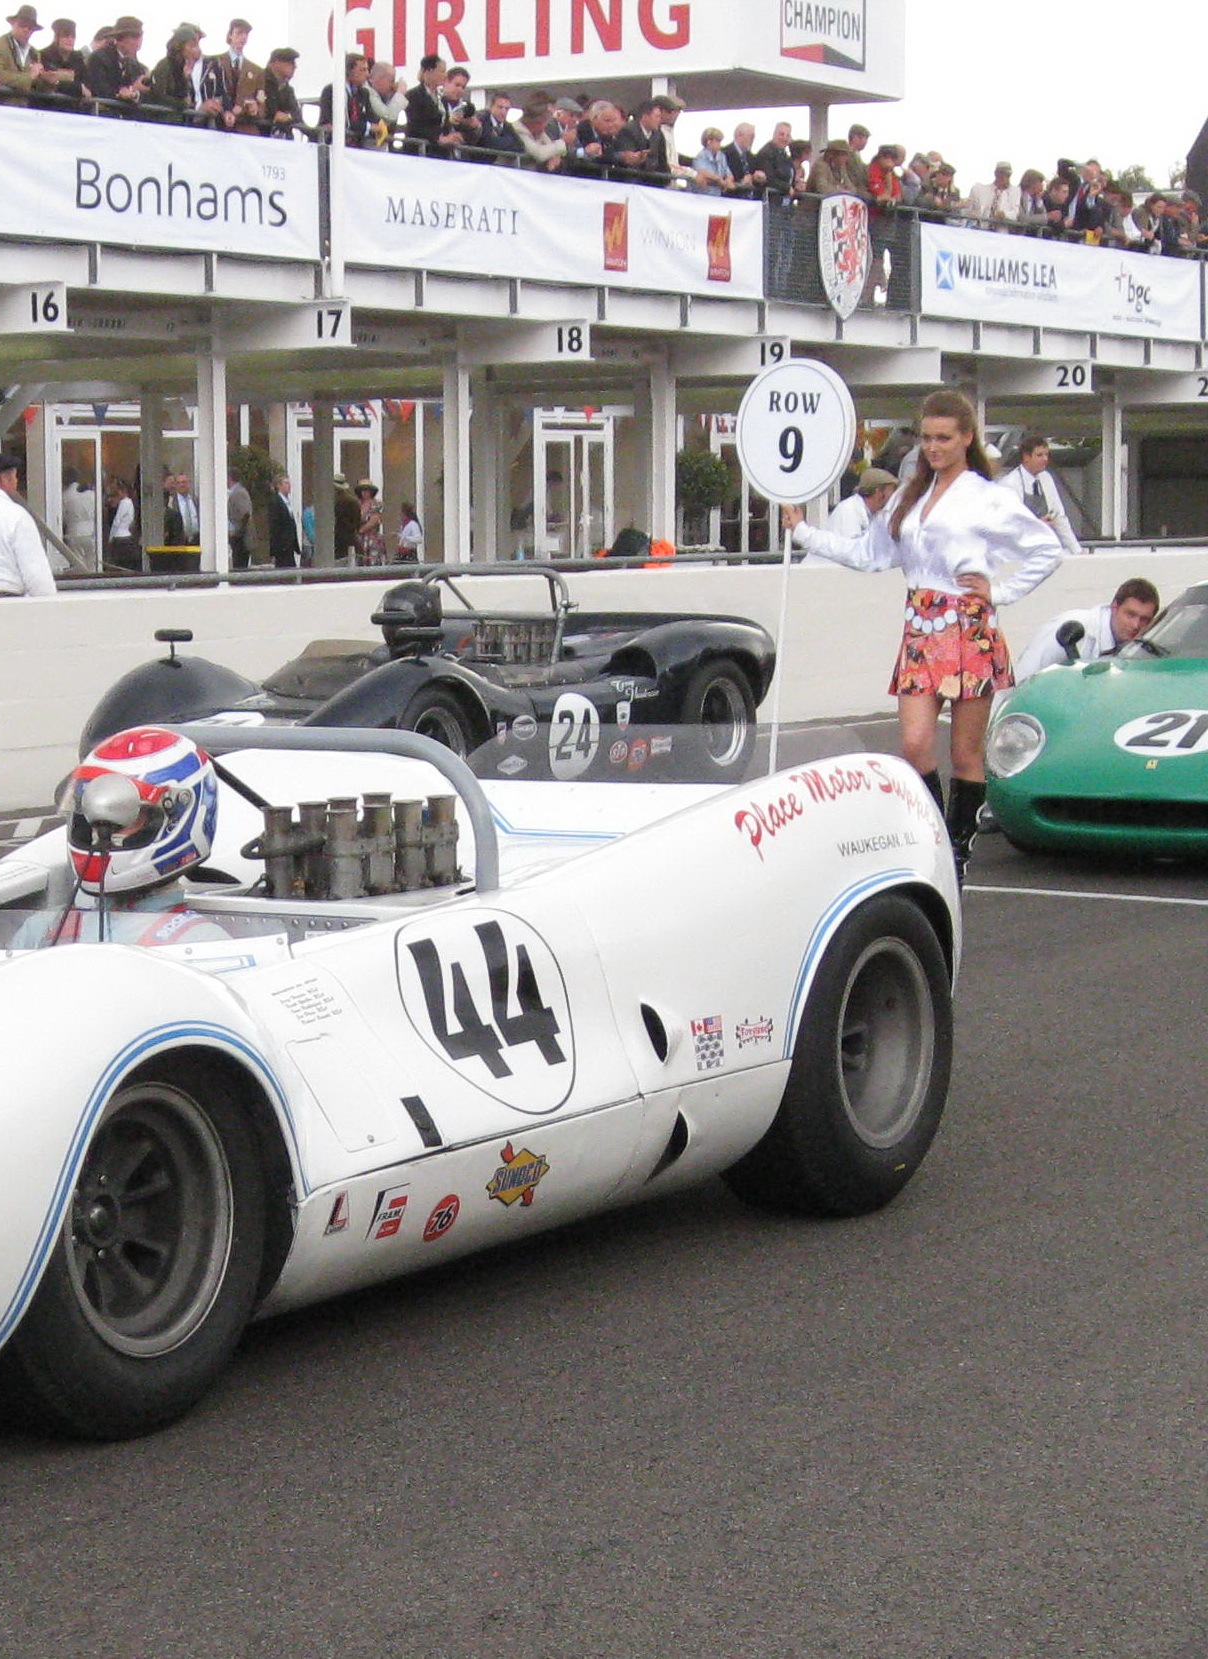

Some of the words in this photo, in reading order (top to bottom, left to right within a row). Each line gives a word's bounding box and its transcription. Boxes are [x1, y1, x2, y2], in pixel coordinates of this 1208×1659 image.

[784, 0, 860, 41] CHAMPION
[262, 164, 286, 181] 1793
[76, 157, 287, 227] Bonhams
[385, 196, 519, 235] MASERATI
[957, 252, 1029, 286] WILLIAMS
[1033, 263, 1057, 290] LEA
[31, 291, 60, 323] 16
[1127, 275, 1151, 313] bgc
[317, 309, 342, 338] 17
[557, 326, 583, 353] 18
[760, 342, 784, 366] 19
[1056, 364, 1086, 388] 20
[769, 390, 821, 413] ROW
[778, 425, 804, 473] 9
[555, 707, 593, 761] 24
[1125, 712, 1208, 748] 21
[734, 793, 803, 862] Place
[789, 768, 871, 803] Motor
[406, 920, 567, 1079] 44
[376, 1207, 402, 1223] FRAM
[431, 1203, 453, 1233] 76
